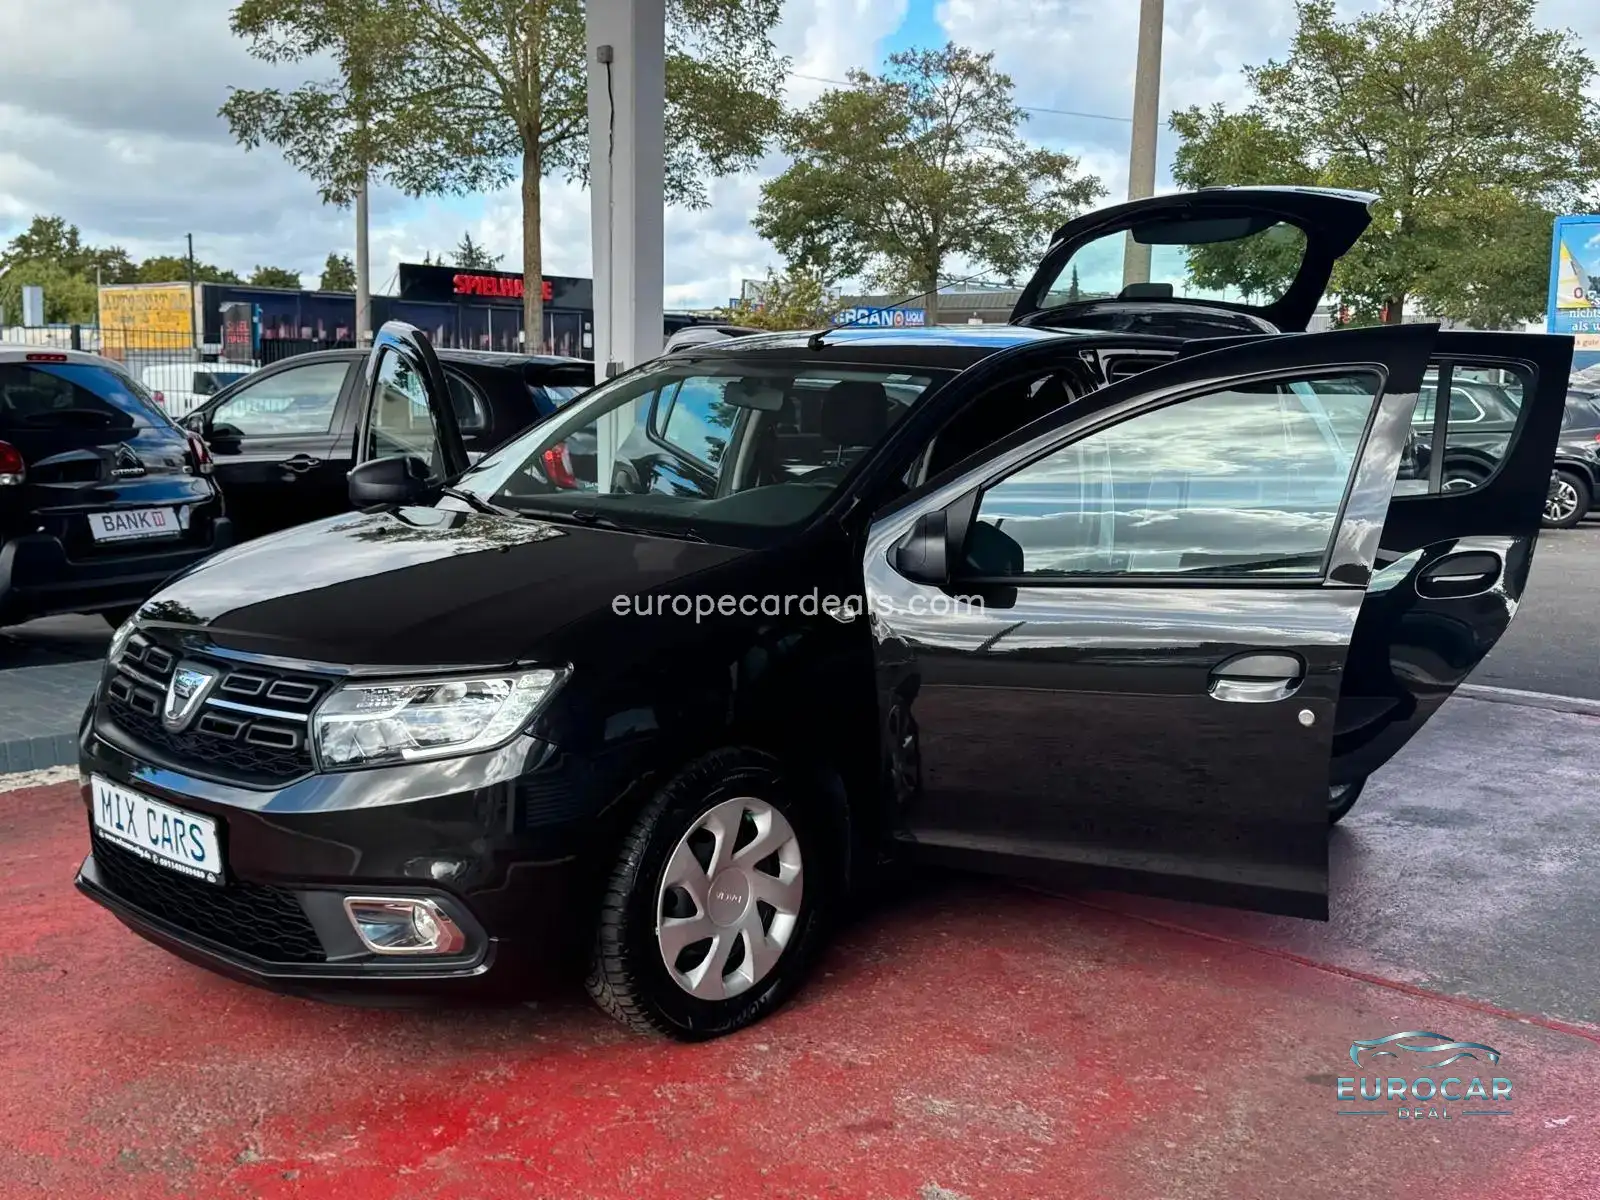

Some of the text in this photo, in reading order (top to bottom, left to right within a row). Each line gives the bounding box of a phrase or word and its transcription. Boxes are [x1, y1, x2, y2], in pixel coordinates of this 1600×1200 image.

[453, 274, 552, 300] SPIELHAE
[102, 511, 152, 532] BANK
[100, 786, 138, 838] MIX
[146, 807, 206, 862] CARS
